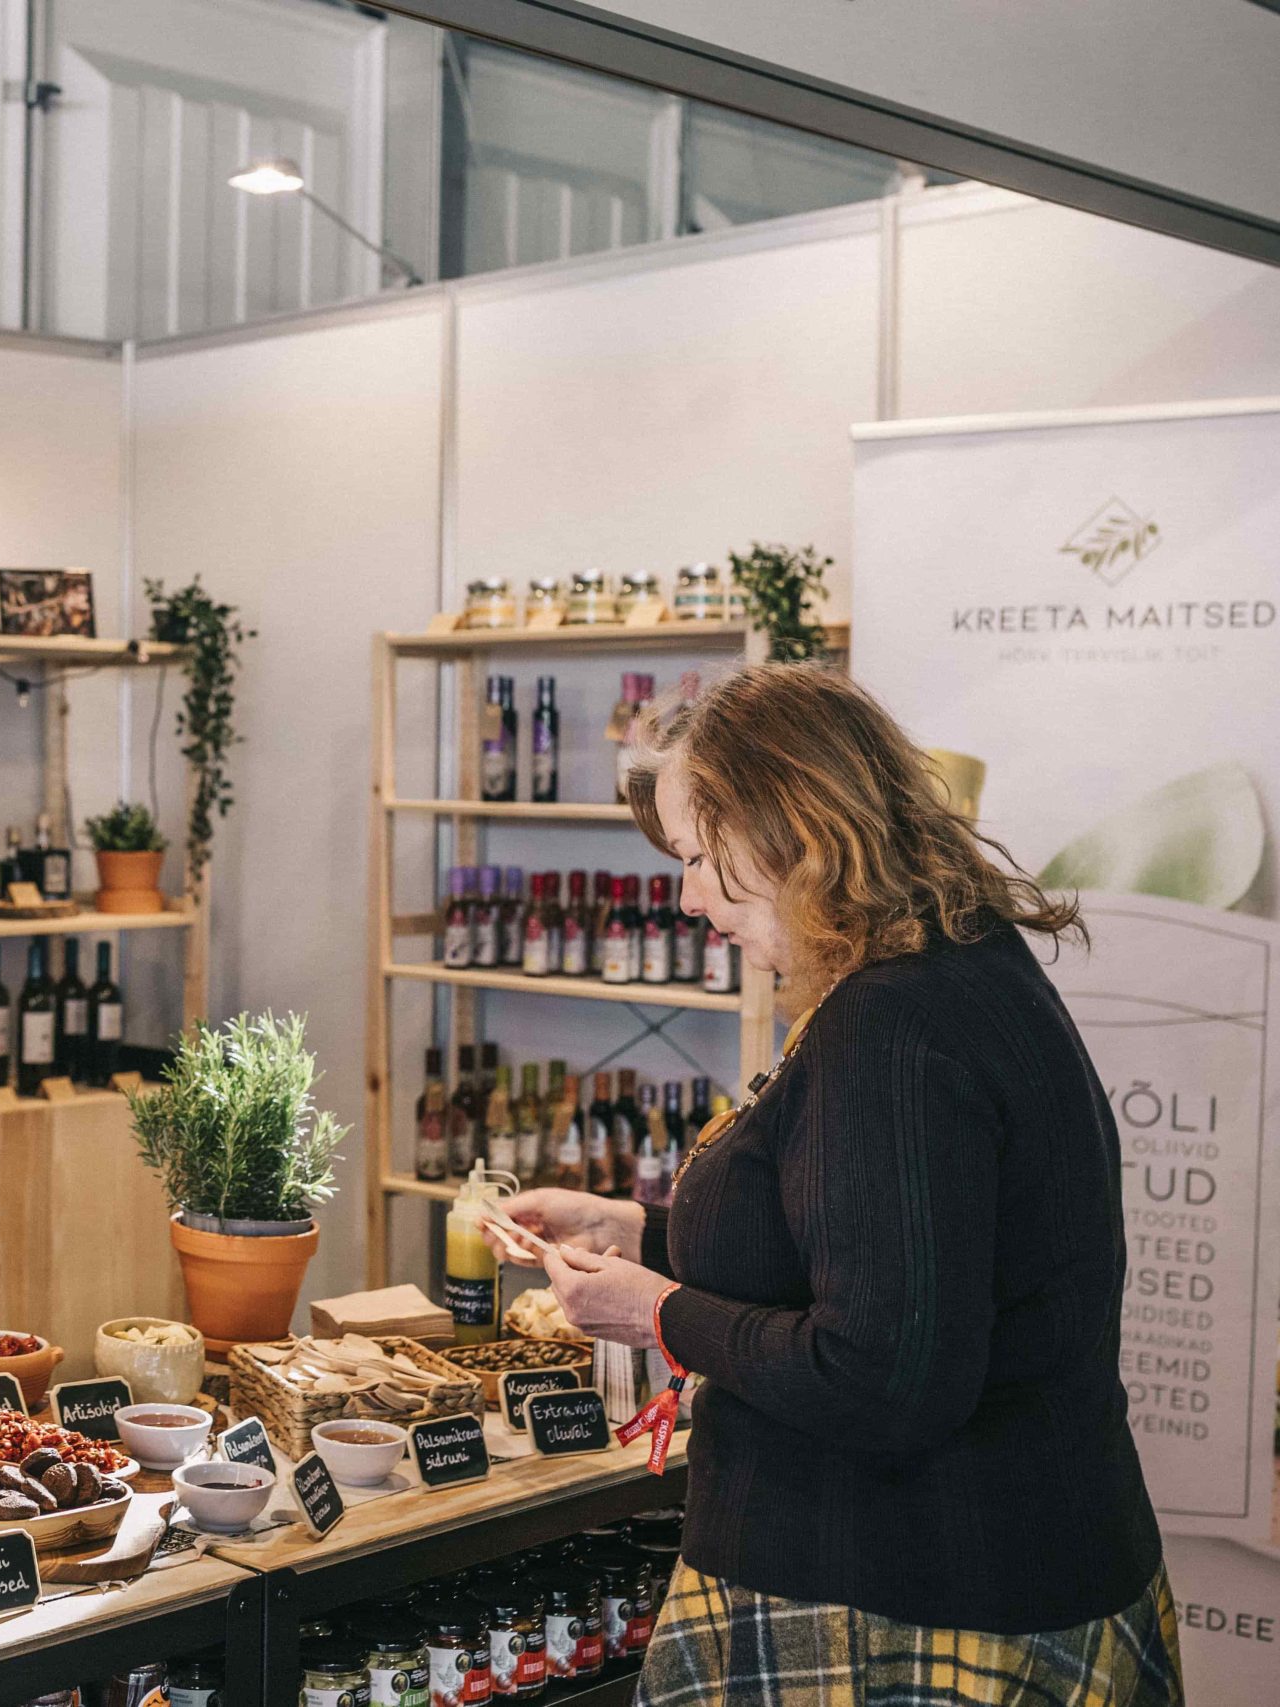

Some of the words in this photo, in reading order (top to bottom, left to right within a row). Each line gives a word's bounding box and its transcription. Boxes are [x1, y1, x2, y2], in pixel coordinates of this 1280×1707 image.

[953, 606, 1089, 633] KREETA
[1107, 601, 1276, 630] MAITSED
[1109, 1079, 1217, 1132] ÕLI
[1131, 1136, 1219, 1161] OLIIVID
[1131, 1207, 1218, 1234] TOOTED
[1133, 1233, 1215, 1265] TEED
[533, 1402, 570, 1420] Extra
[651, 1418, 669, 1467] EKSPONENT
[426, 1447, 470, 1471] sidruni
